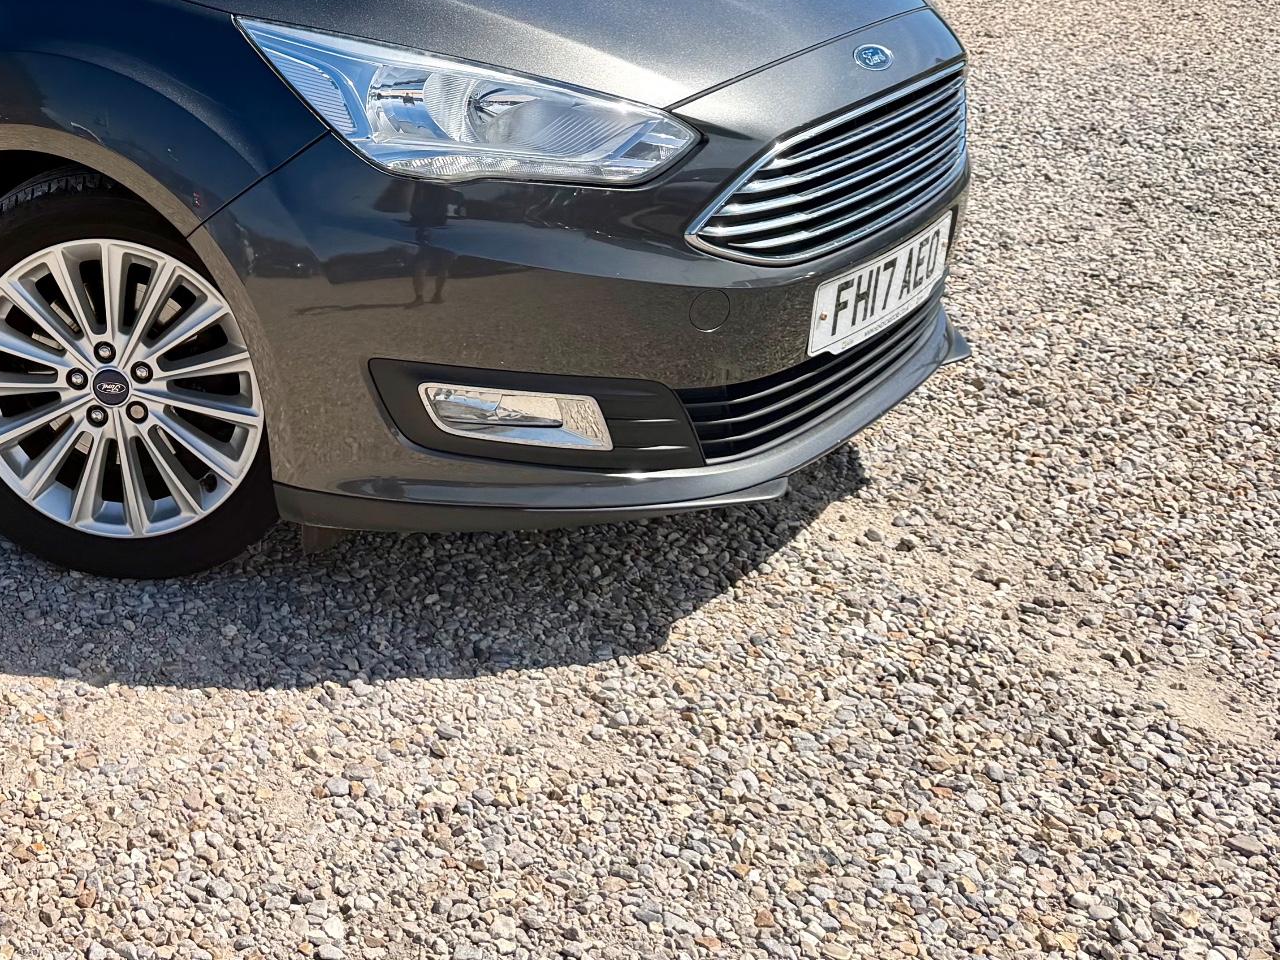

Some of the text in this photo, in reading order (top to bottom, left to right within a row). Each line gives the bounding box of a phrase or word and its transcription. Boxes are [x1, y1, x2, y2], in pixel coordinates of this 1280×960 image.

[861, 49, 886, 65] Ford
[831, 257, 898, 336] FH17
[102, 383, 121, 392] Ford
